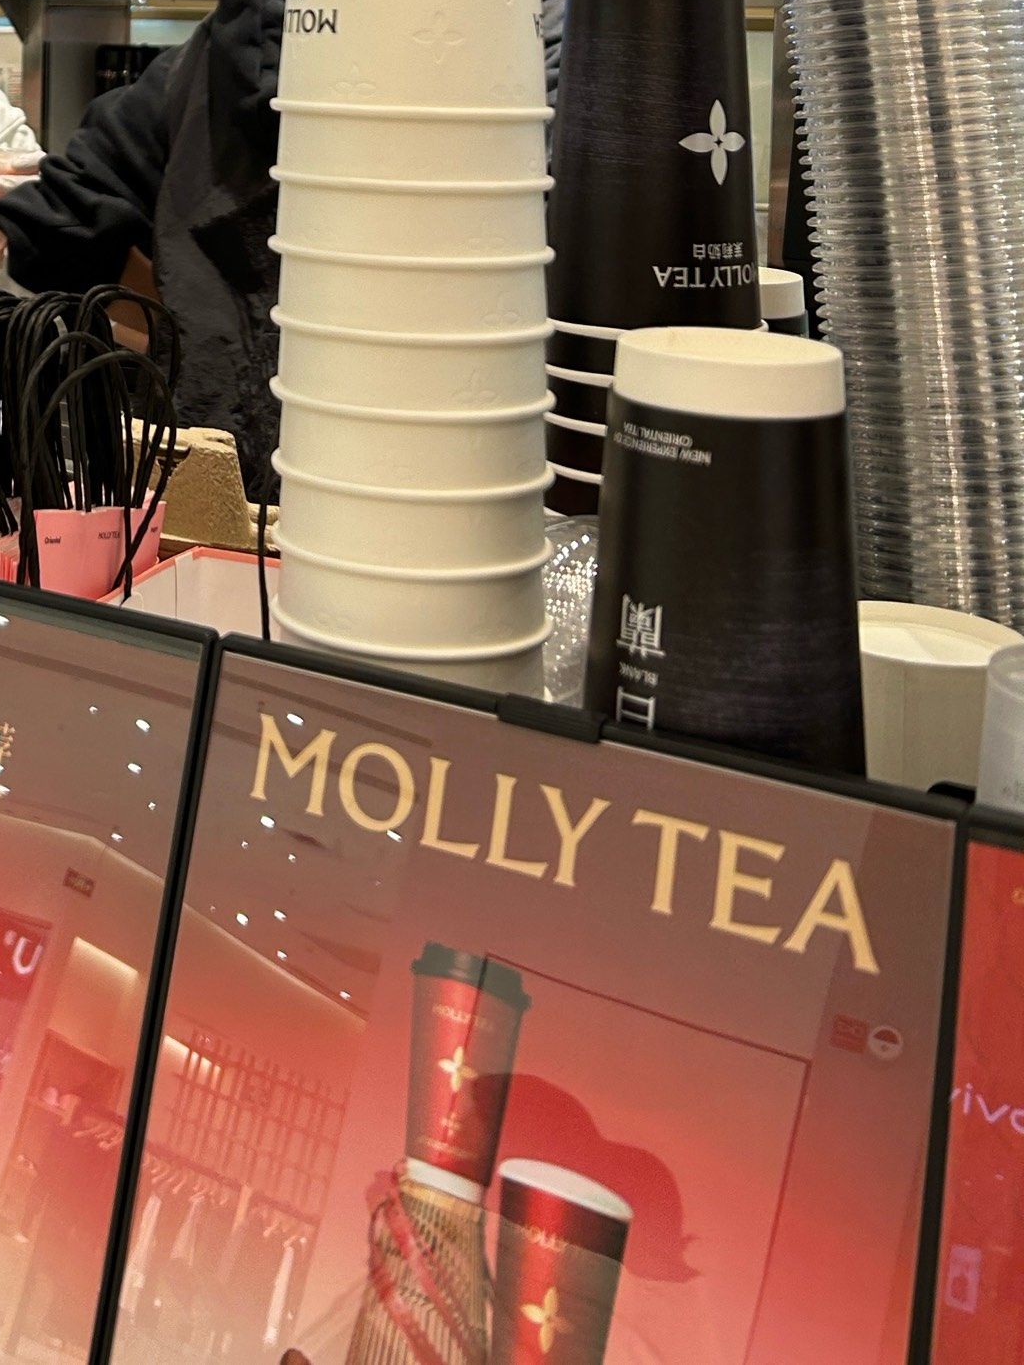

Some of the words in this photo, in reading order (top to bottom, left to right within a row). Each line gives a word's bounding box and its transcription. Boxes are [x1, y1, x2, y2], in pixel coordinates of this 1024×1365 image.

[285, 8, 337, 34] MOLL
[652, 265, 707, 288] TEA
[249, 712, 611, 889] MOLLY
[630, 809, 881, 976] TEA
